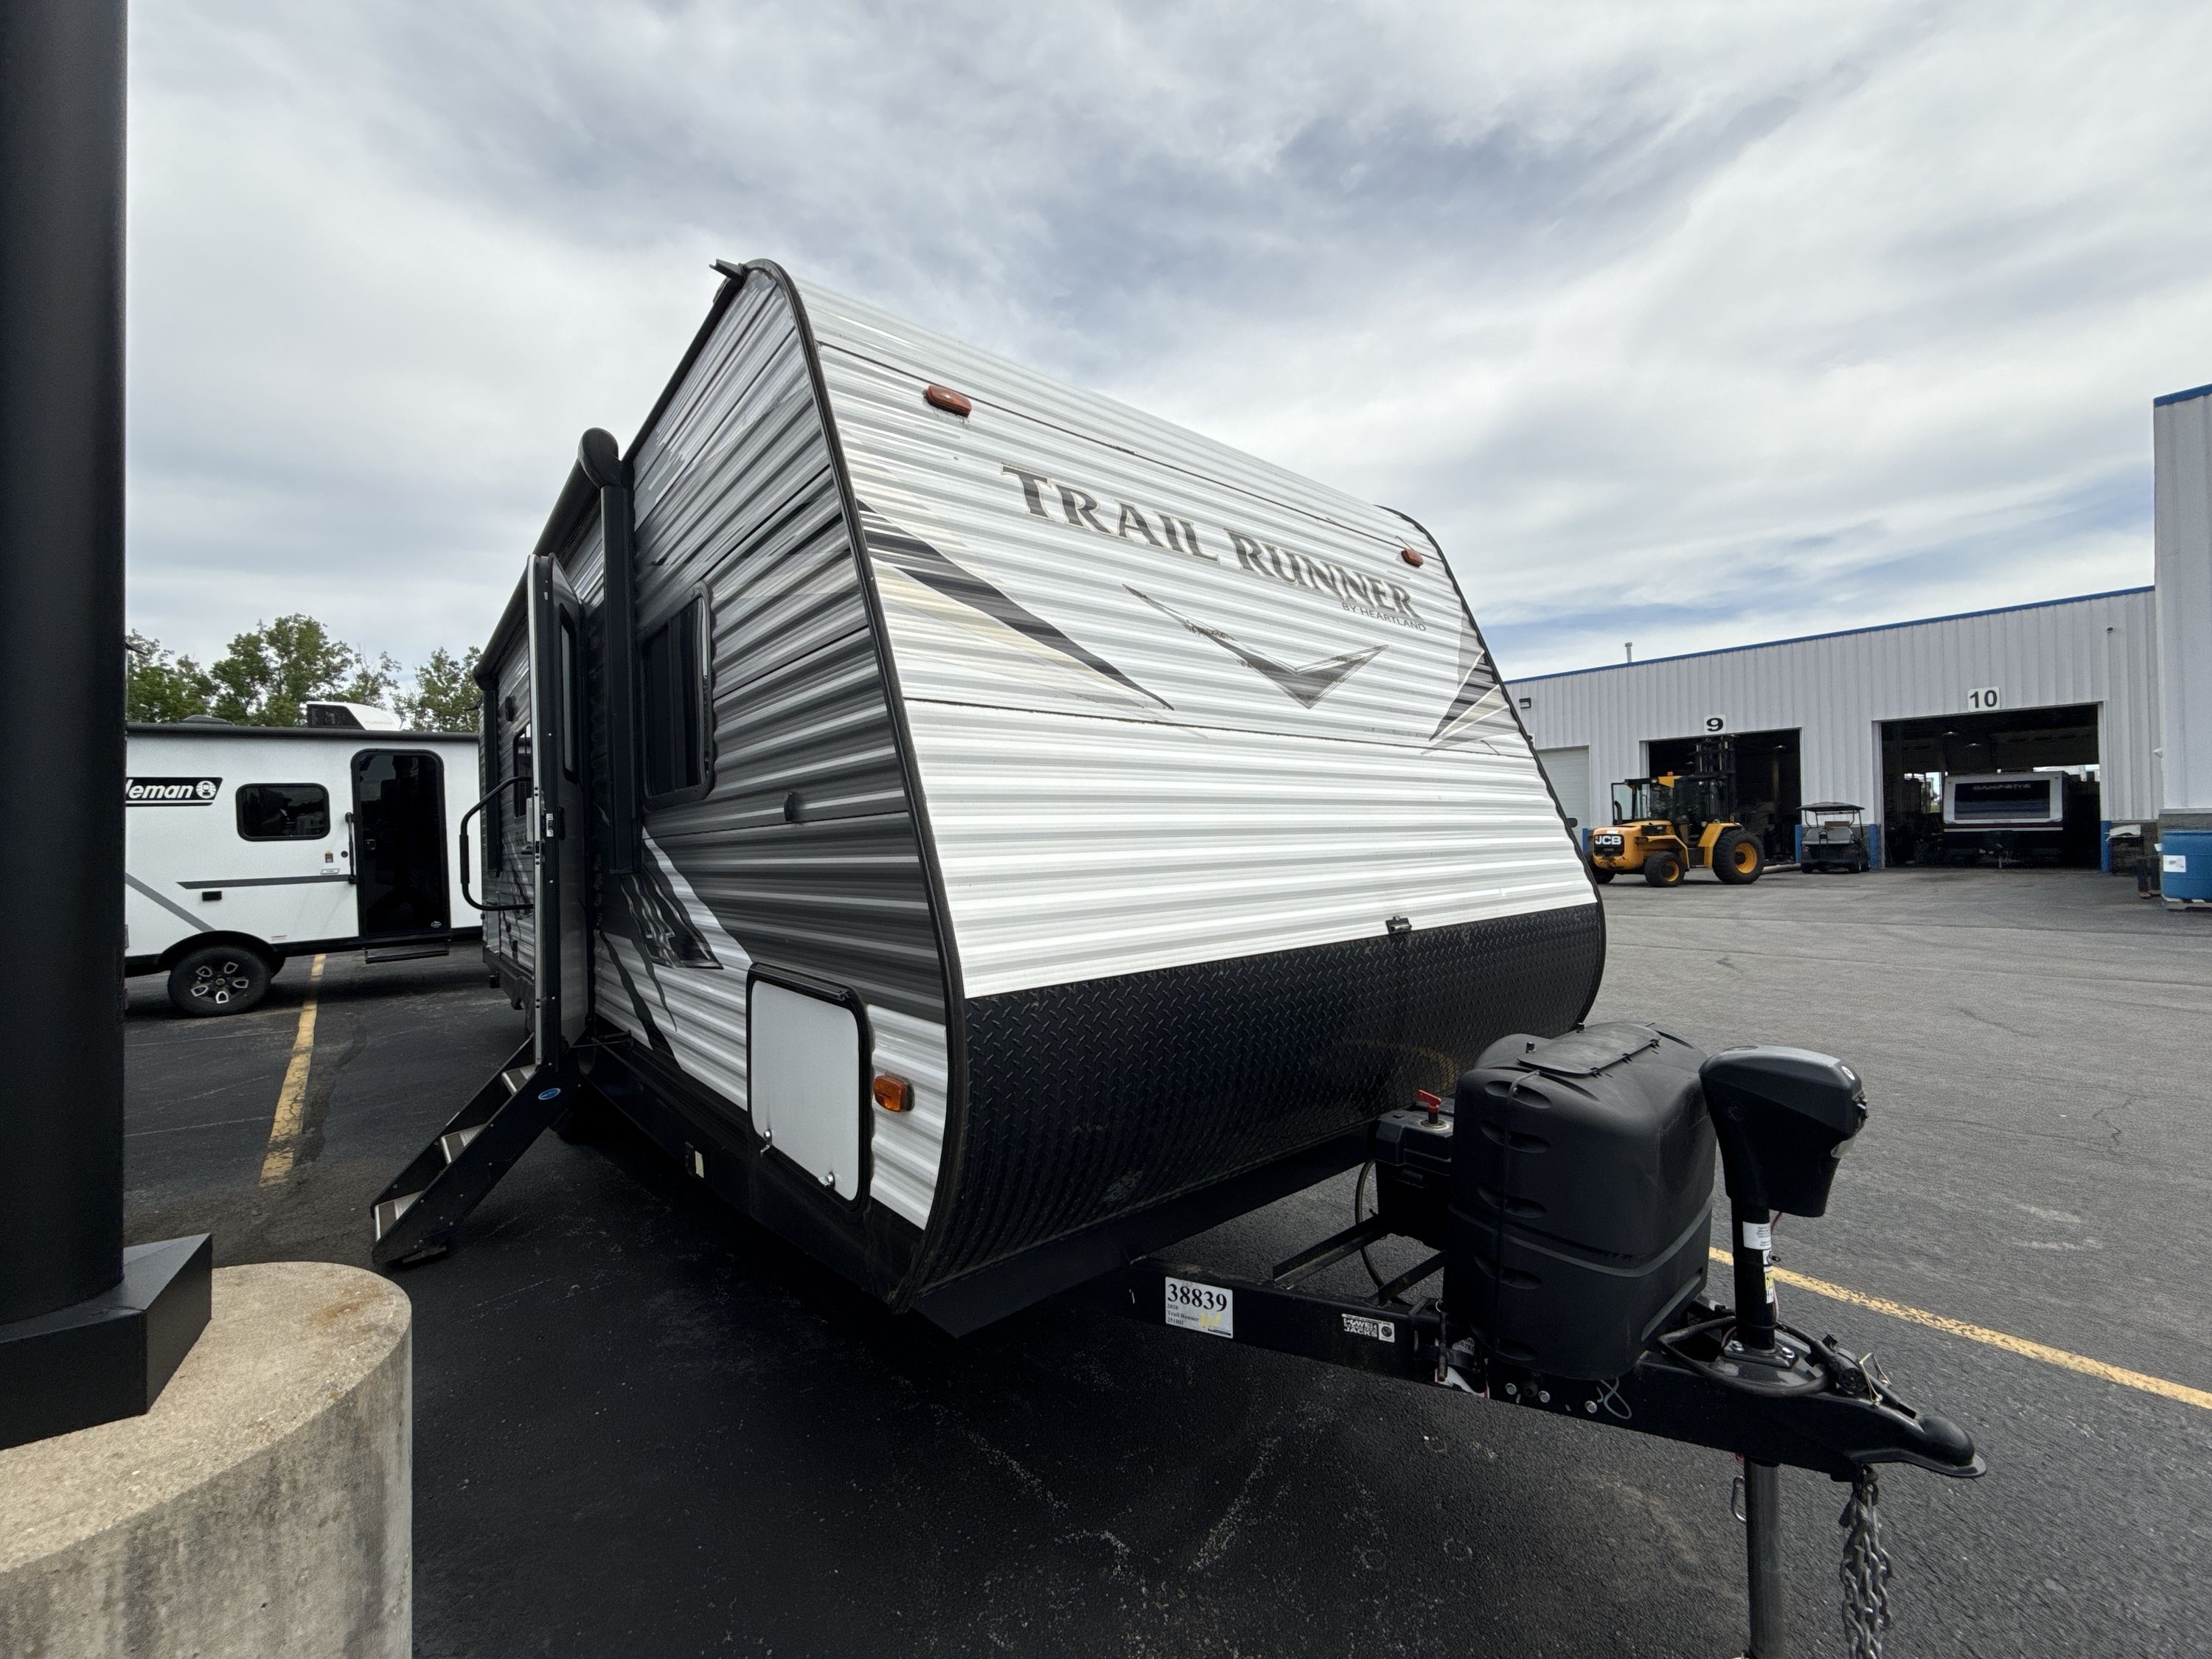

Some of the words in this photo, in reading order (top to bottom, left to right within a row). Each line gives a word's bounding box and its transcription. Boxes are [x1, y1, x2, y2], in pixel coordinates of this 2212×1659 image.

[1001, 462, 1220, 564] TRAIL
[1223, 527, 1424, 621] RUNNER
[1341, 602, 1357, 613] BY
[1360, 608, 1427, 632] HEARTLAND
[1969, 689, 1997, 709] 10
[1706, 717, 1724, 732] 9
[125, 779, 194, 799] leman
[1595, 835, 1622, 845] JCB
[1167, 1283, 1228, 1312] 38839
[1167, 1310, 1180, 1318] Trail
[1180, 1312, 1199, 1322] Runner
[1343, 1326, 1378, 1338] JACKS
